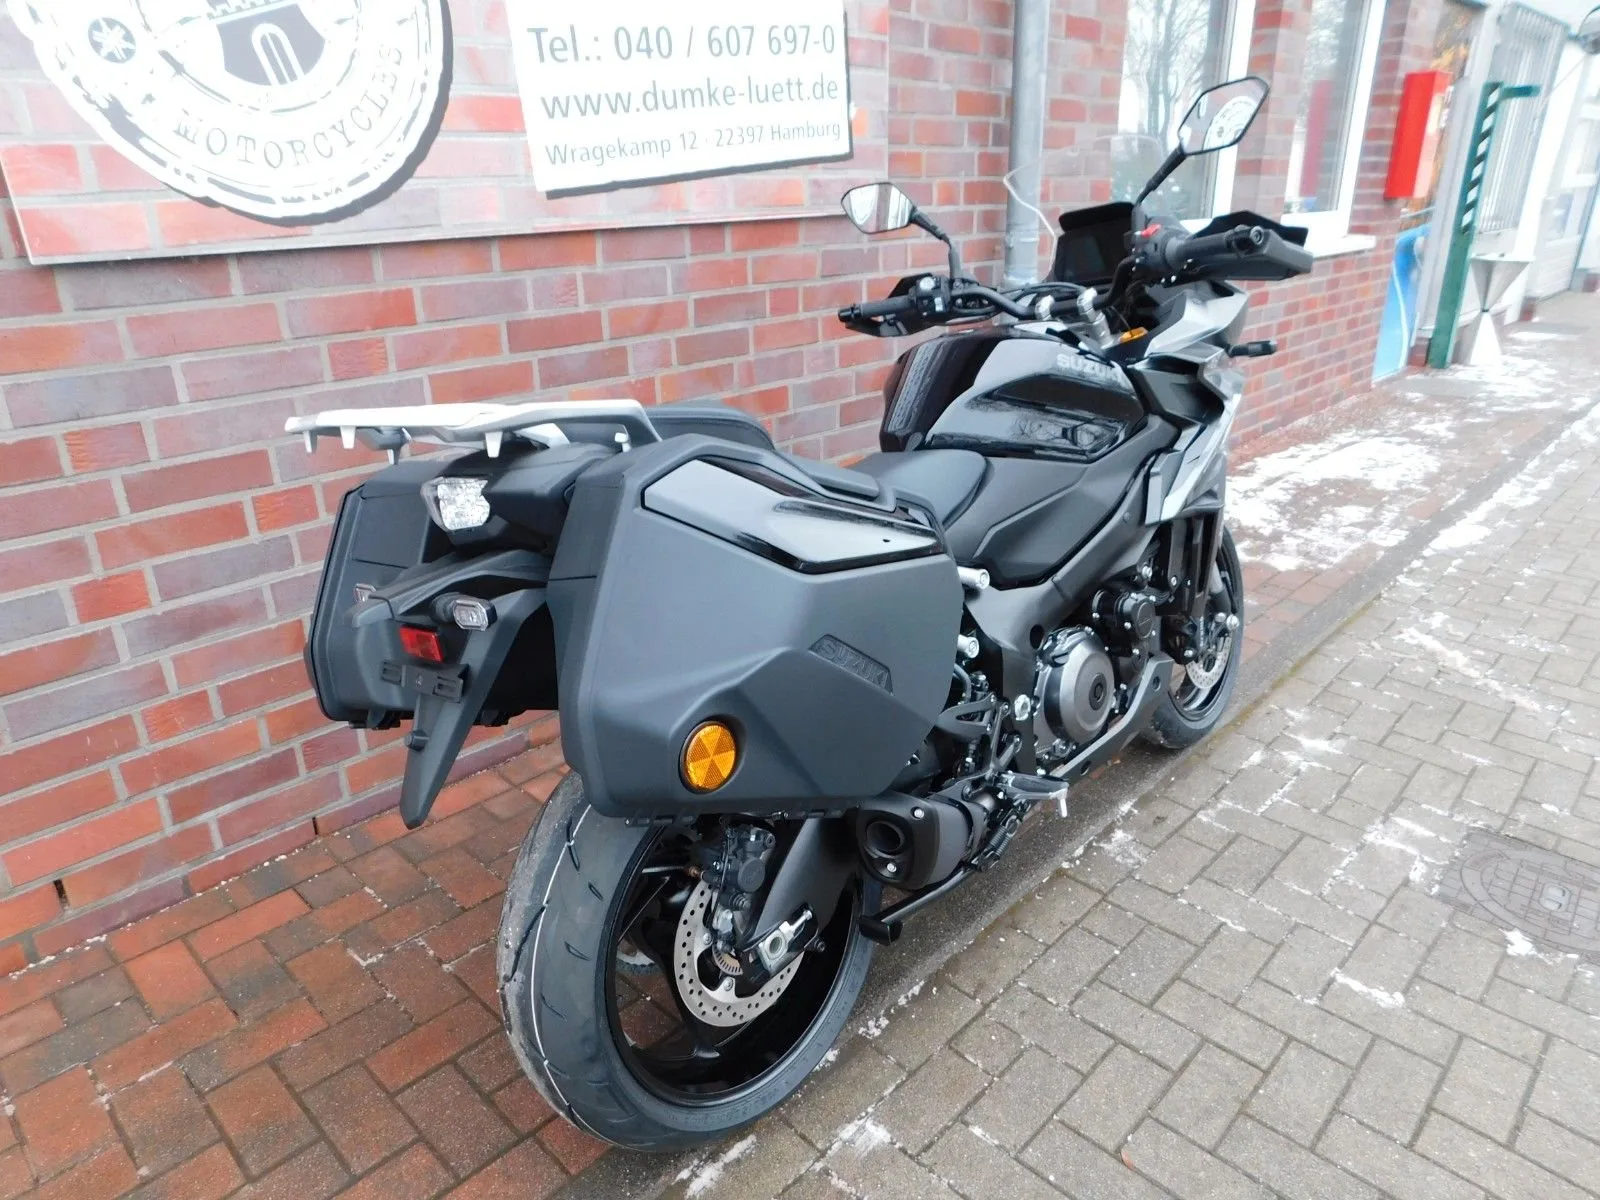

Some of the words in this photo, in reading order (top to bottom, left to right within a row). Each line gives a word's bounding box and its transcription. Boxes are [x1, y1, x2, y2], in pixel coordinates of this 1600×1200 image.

[526, 24, 601, 64] Tel.:
[613, 25, 673, 61] 040
[686, 25, 695, 58] /
[707, 24, 755, 58] 607
[767, 24, 835, 56] 697-0
[172, 45, 403, 170] MOTORCYCLES
[540, 72, 839, 120] www.dumke-luett.de
[544, 136, 672, 167] Wragekamp
[679, 131, 698, 151] 12
[715, 124, 764, 148] 22397
[770, 121, 841, 142] Hamburg
[819, 638, 889, 689] SUZUKI
